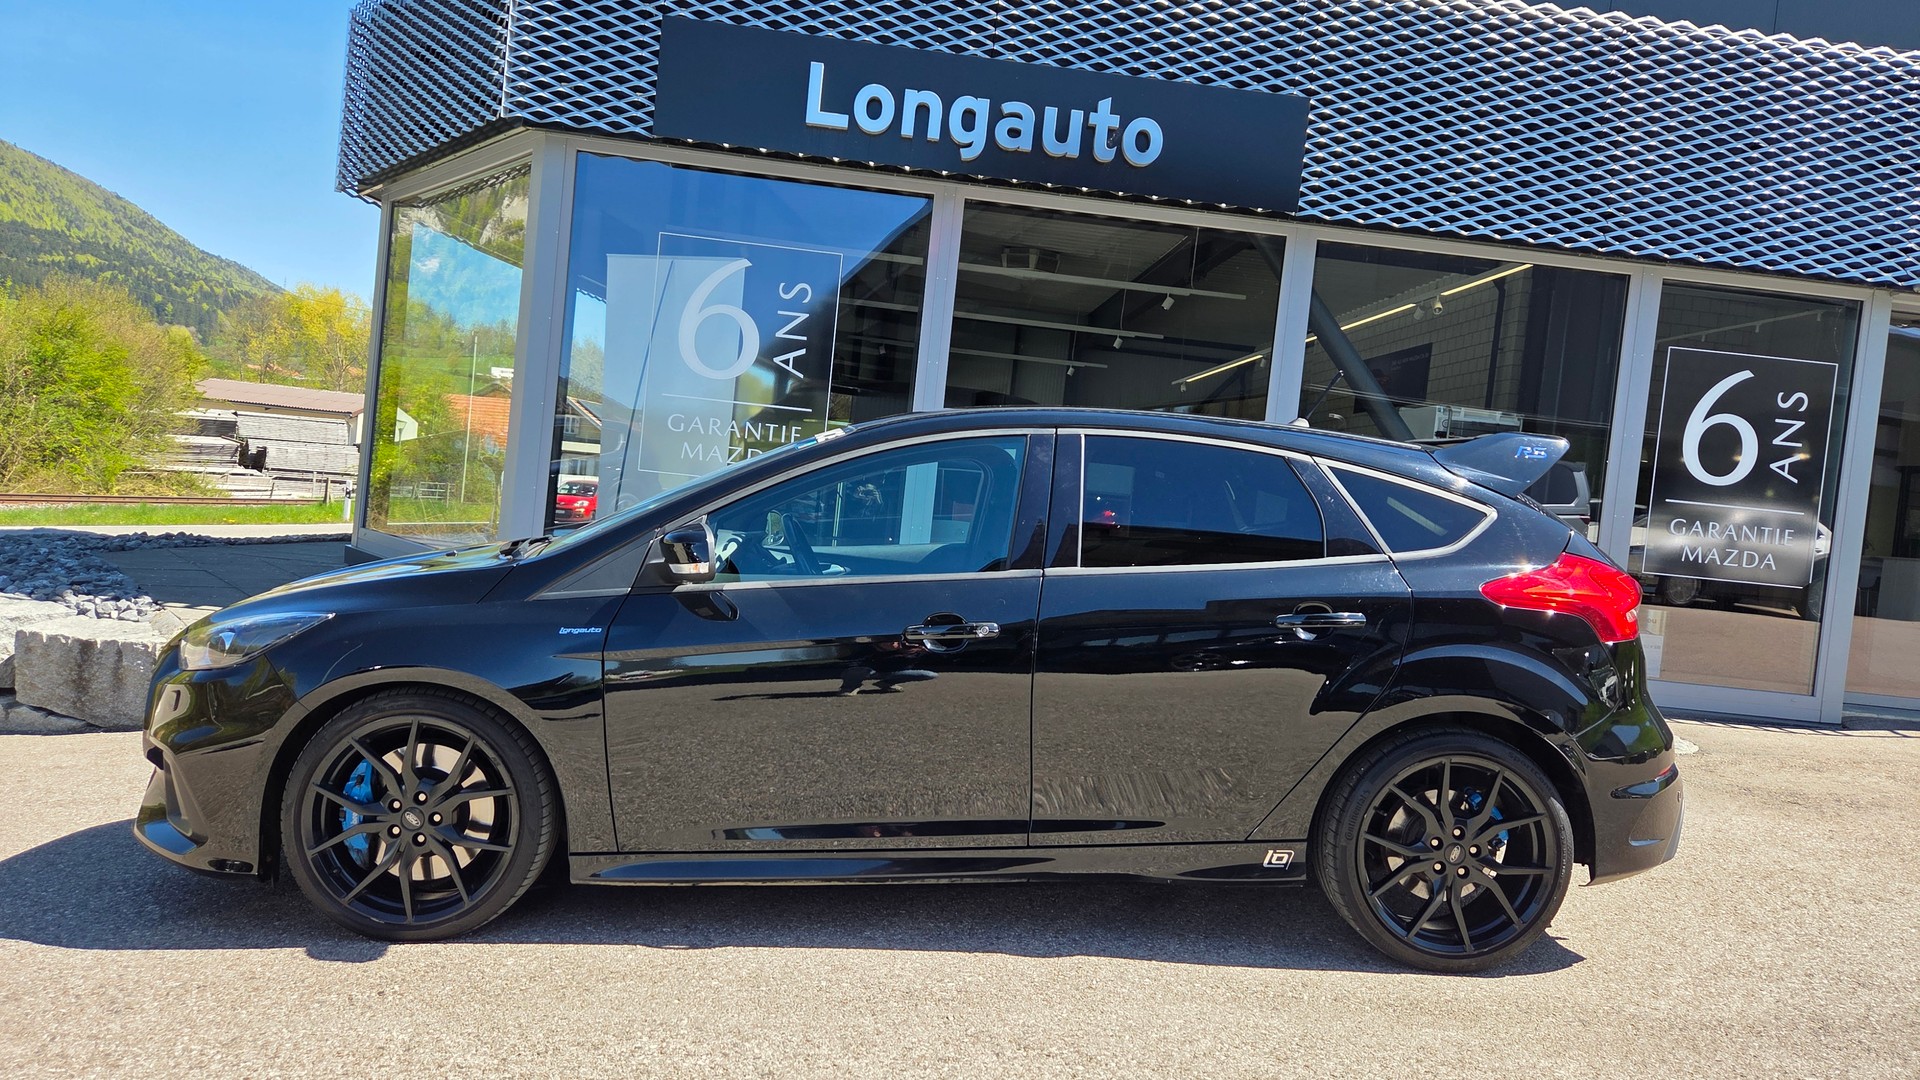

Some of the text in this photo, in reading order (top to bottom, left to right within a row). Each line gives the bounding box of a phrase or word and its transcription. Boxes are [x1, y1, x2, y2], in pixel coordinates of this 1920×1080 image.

[805, 61, 1164, 167] Longauto
[678, 258, 812, 380] 6 ANS
[1514, 445, 1548, 459] RS
[1682, 369, 1809, 487] 6 ANS
[1669, 518, 1795, 547] GARANTIE
[1681, 546, 1777, 571] MAZDA
